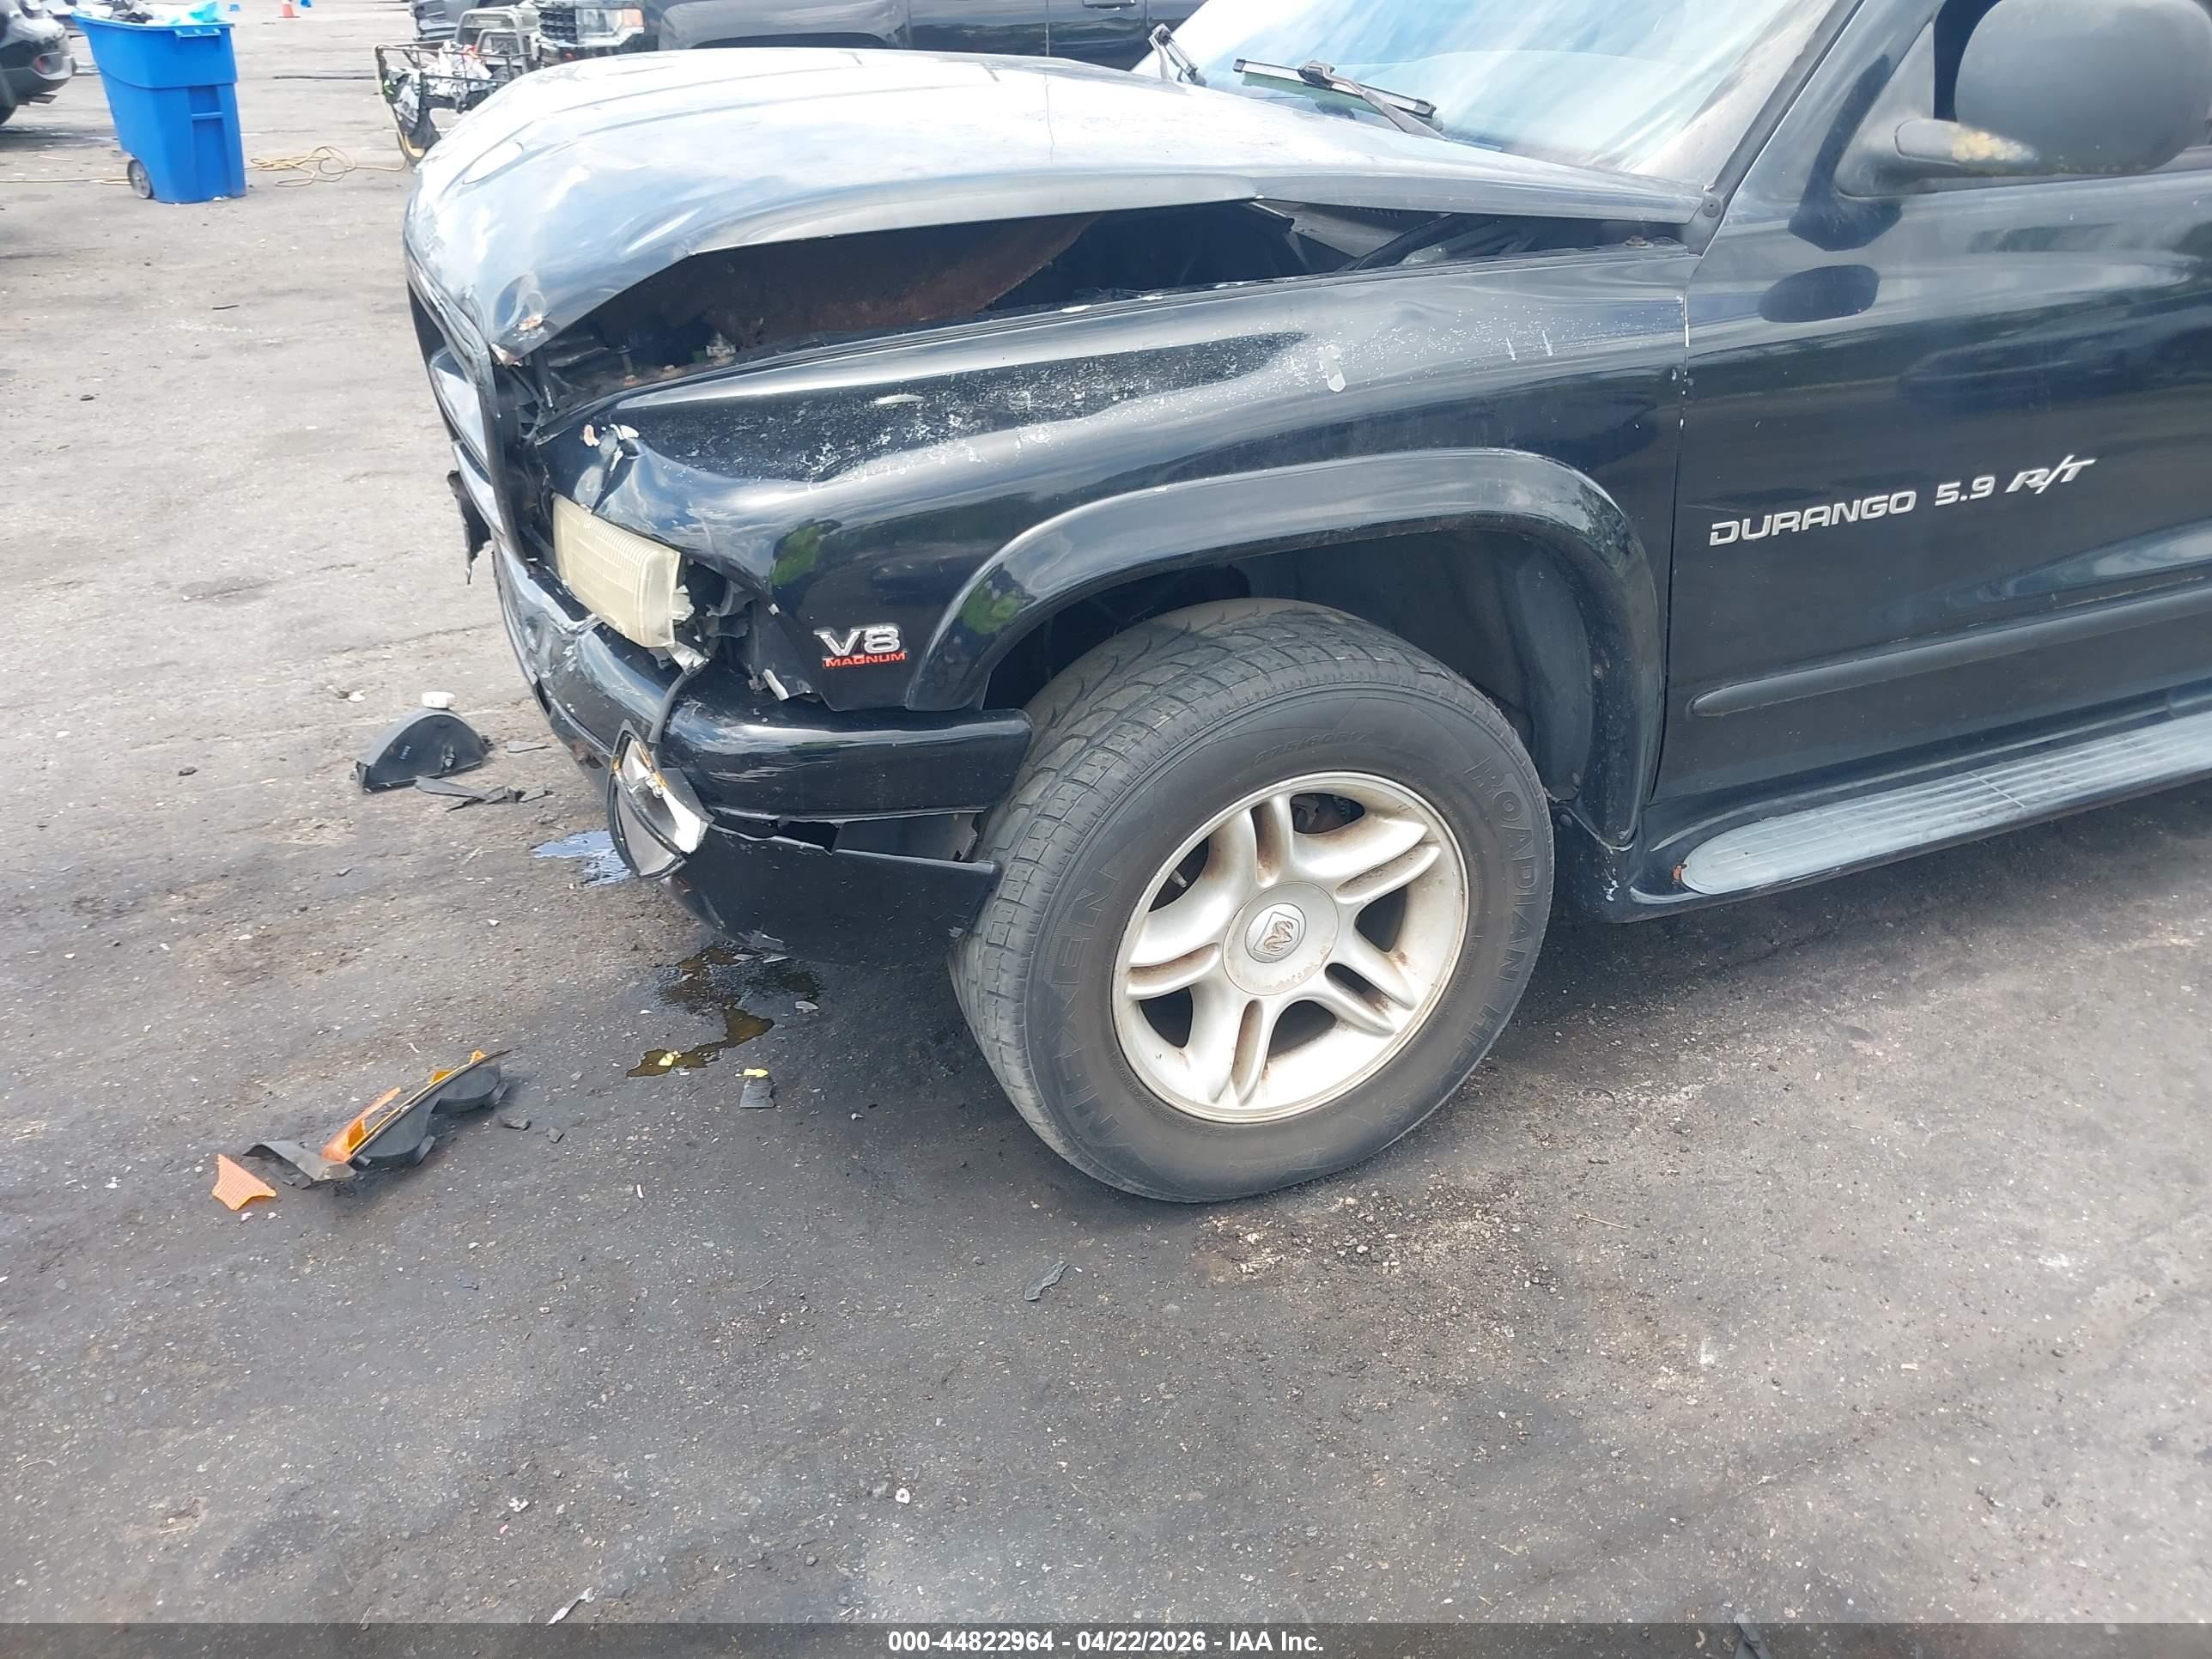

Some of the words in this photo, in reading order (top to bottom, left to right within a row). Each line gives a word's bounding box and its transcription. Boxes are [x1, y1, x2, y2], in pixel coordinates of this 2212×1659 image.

[1709, 490, 1917, 546] DURANGO
[1934, 477, 1996, 507] 5.9
[2006, 454, 2096, 495] R/T
[814, 623, 901, 657] V8
[823, 651, 907, 668] MAGNUM
[1464, 756, 1537, 982] ROADIAN
